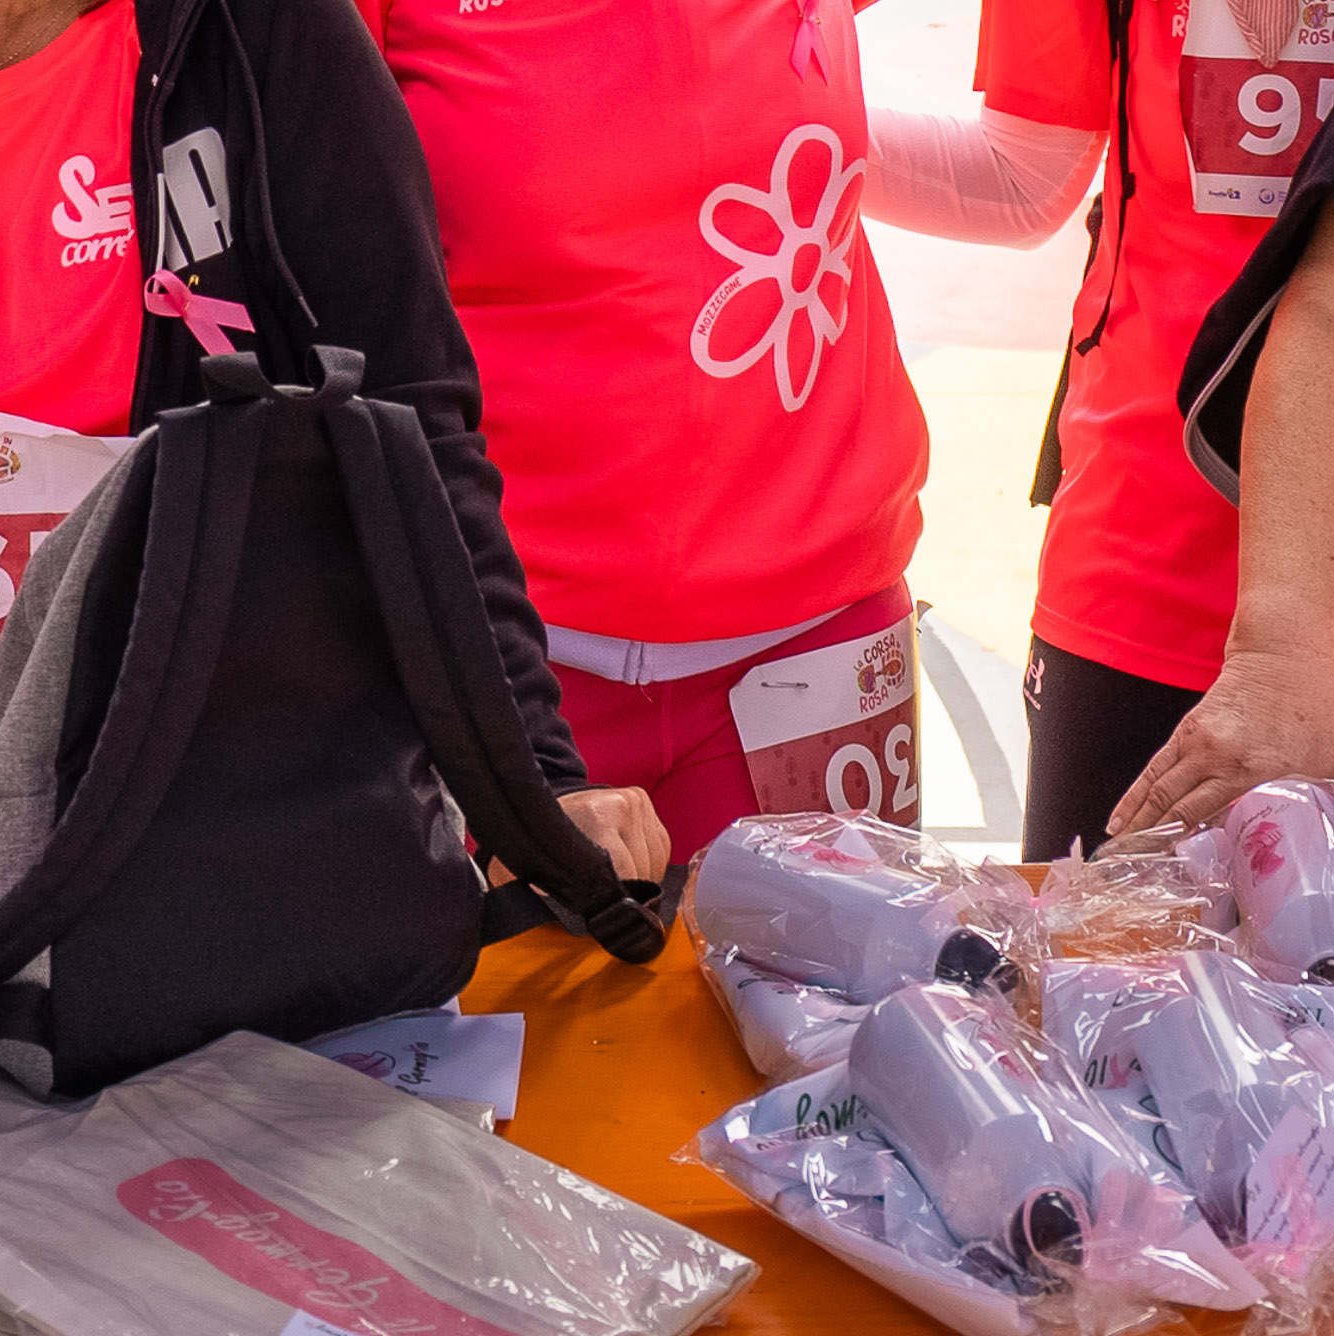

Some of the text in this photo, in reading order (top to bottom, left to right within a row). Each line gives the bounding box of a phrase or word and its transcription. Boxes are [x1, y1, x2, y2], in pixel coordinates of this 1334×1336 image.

[697, 276, 743, 337] MOZZECANE
[863, 633, 896, 665] CORSA
[859, 684, 889, 713] ROSA
